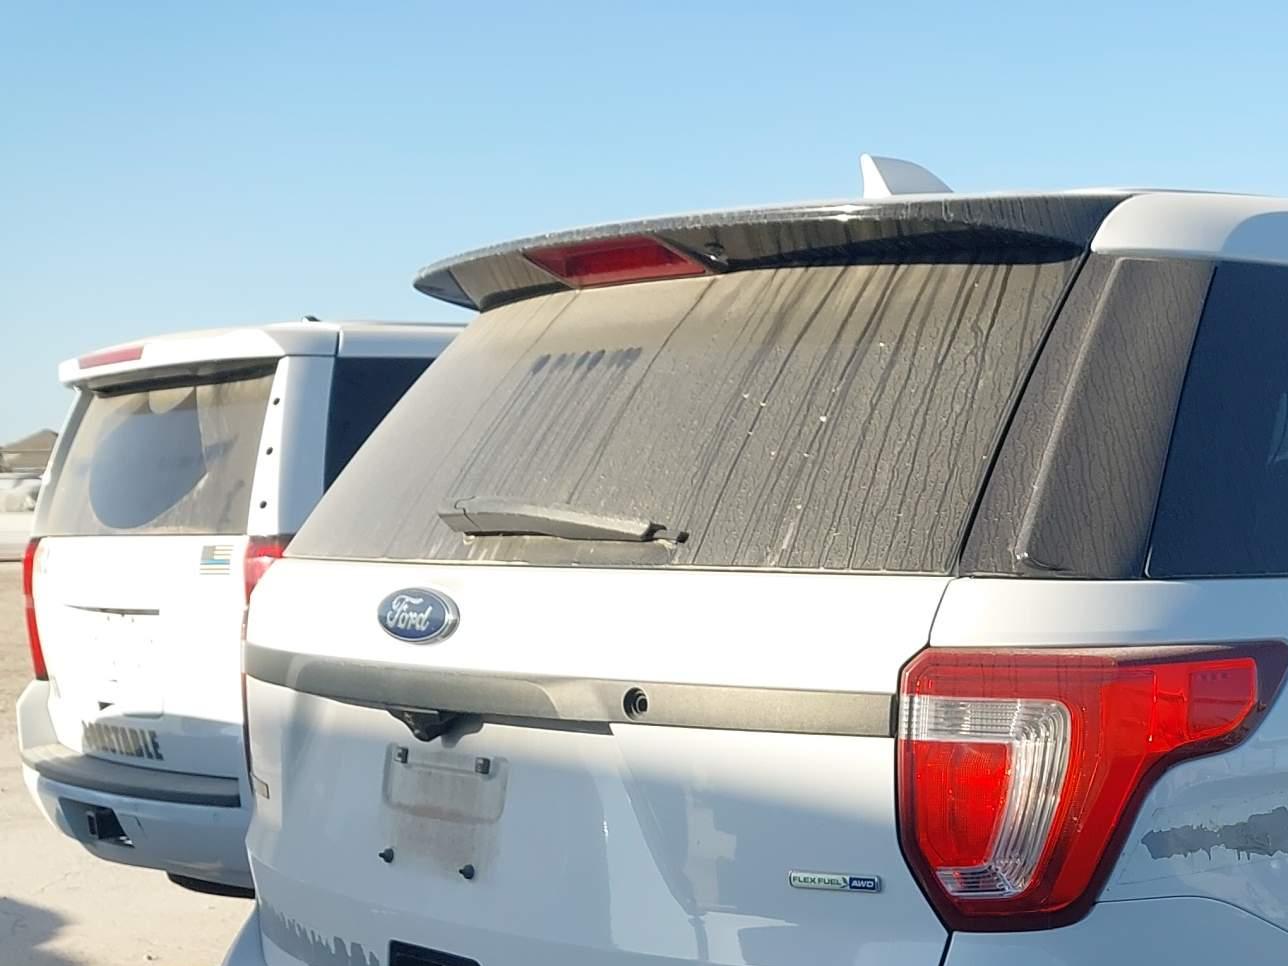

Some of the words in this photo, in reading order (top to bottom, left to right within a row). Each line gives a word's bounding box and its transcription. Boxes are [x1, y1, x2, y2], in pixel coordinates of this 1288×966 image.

[386, 594, 433, 632] Ford
[792, 875, 817, 885] FLEX
[818, 877, 843, 886] FUEL
[850, 879, 875, 888] AWD
